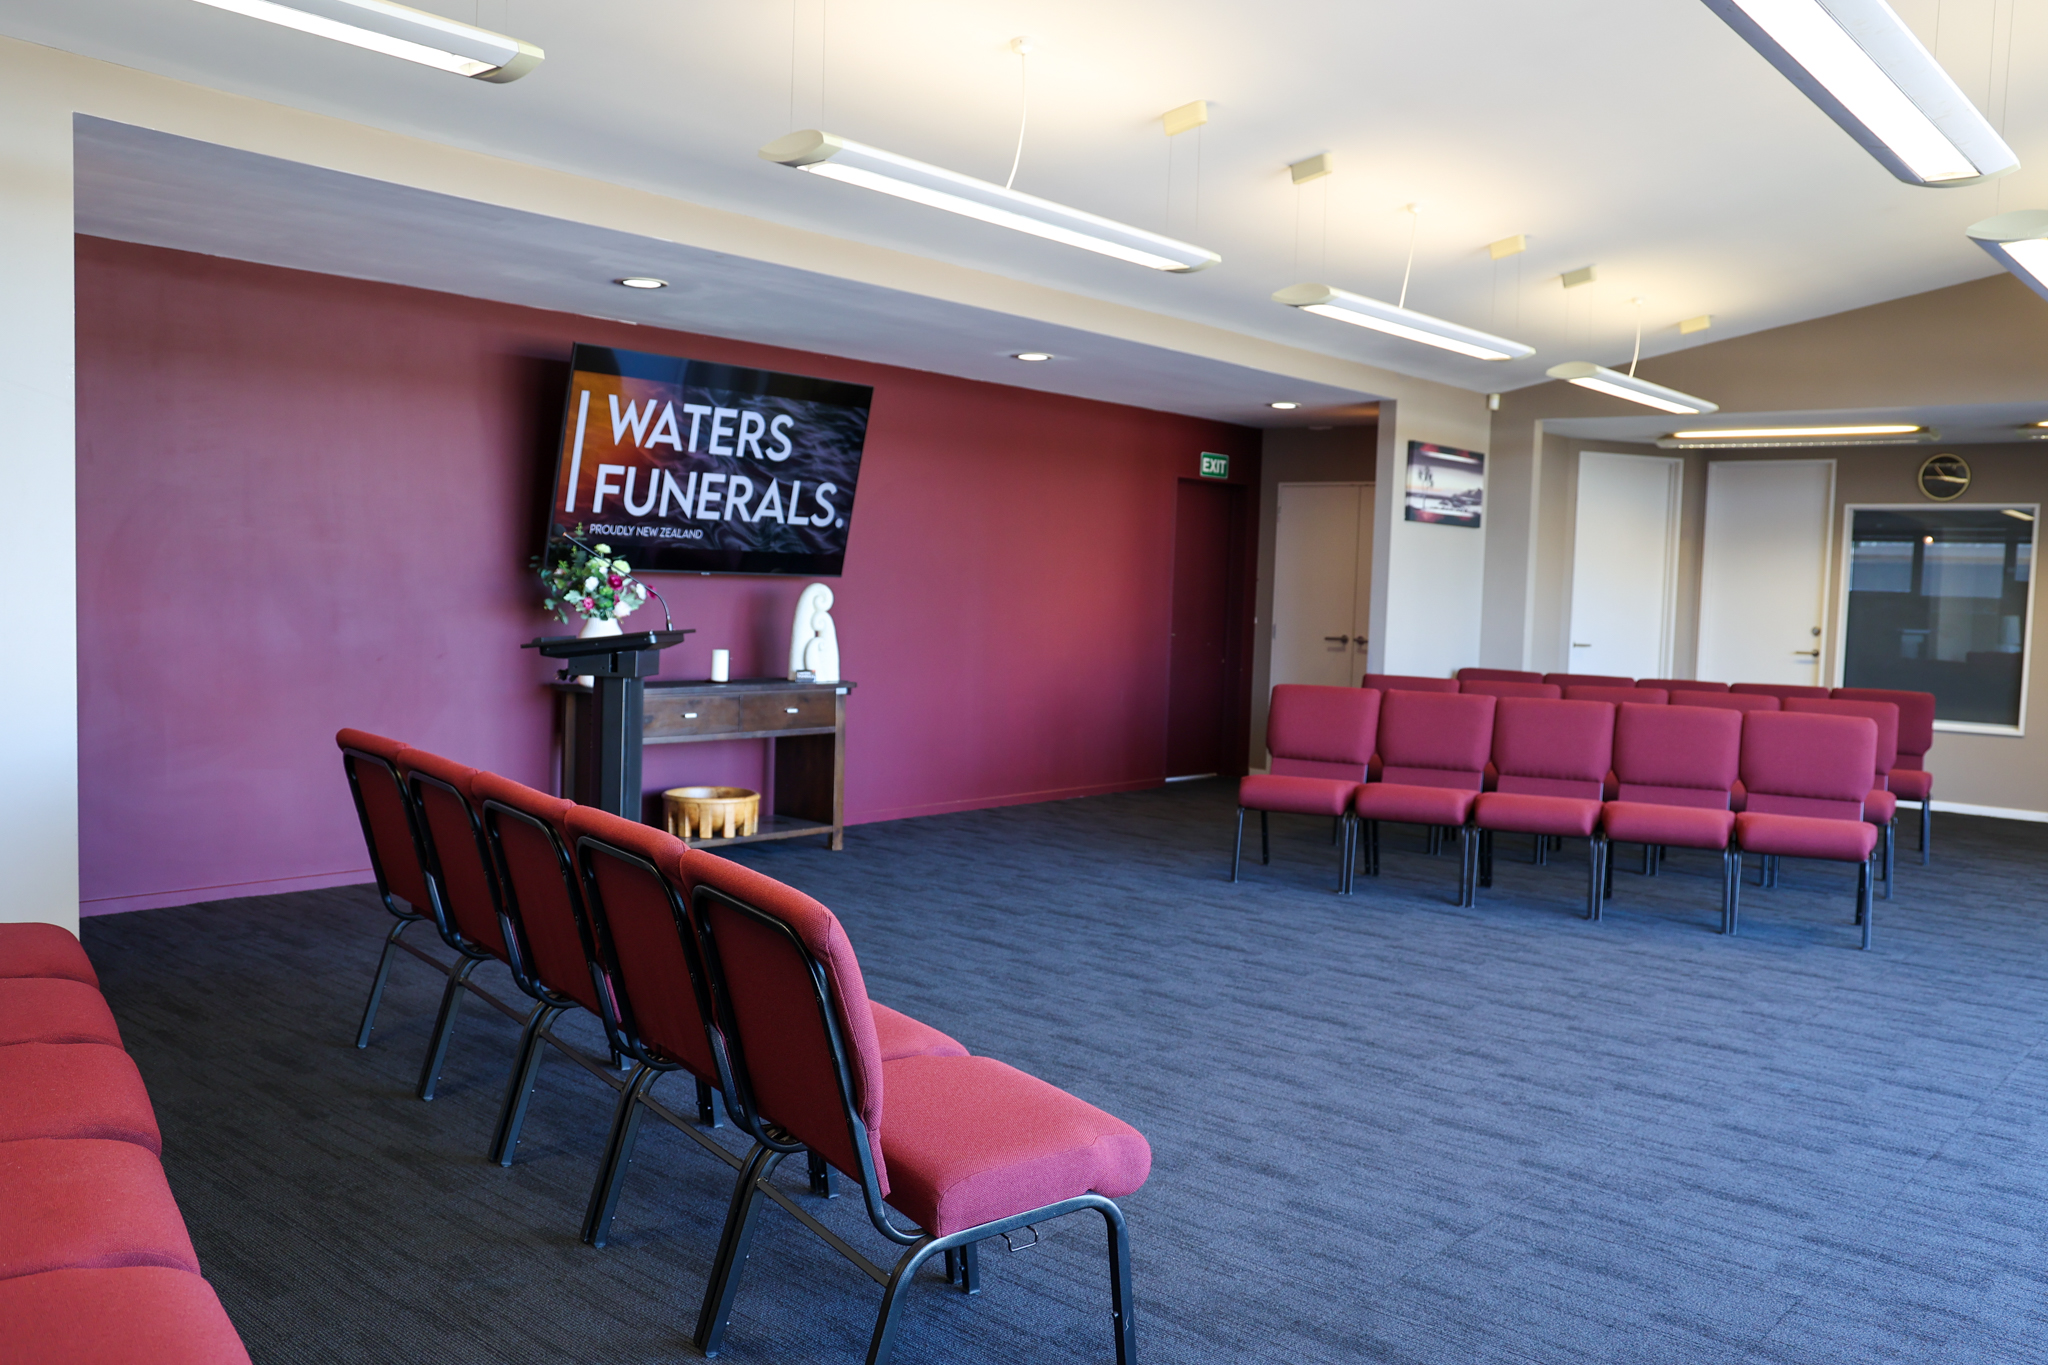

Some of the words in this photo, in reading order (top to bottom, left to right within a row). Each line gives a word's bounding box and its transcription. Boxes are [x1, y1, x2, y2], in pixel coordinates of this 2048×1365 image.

[608, 395, 793, 462] WATERS
[1203, 457, 1226, 474] EXIT
[592, 464, 843, 528] FUNERALS.
[589, 524, 635, 535] PROUDLY
[636, 527, 659, 537] NEW
[660, 528, 703, 539] ZEALAND
